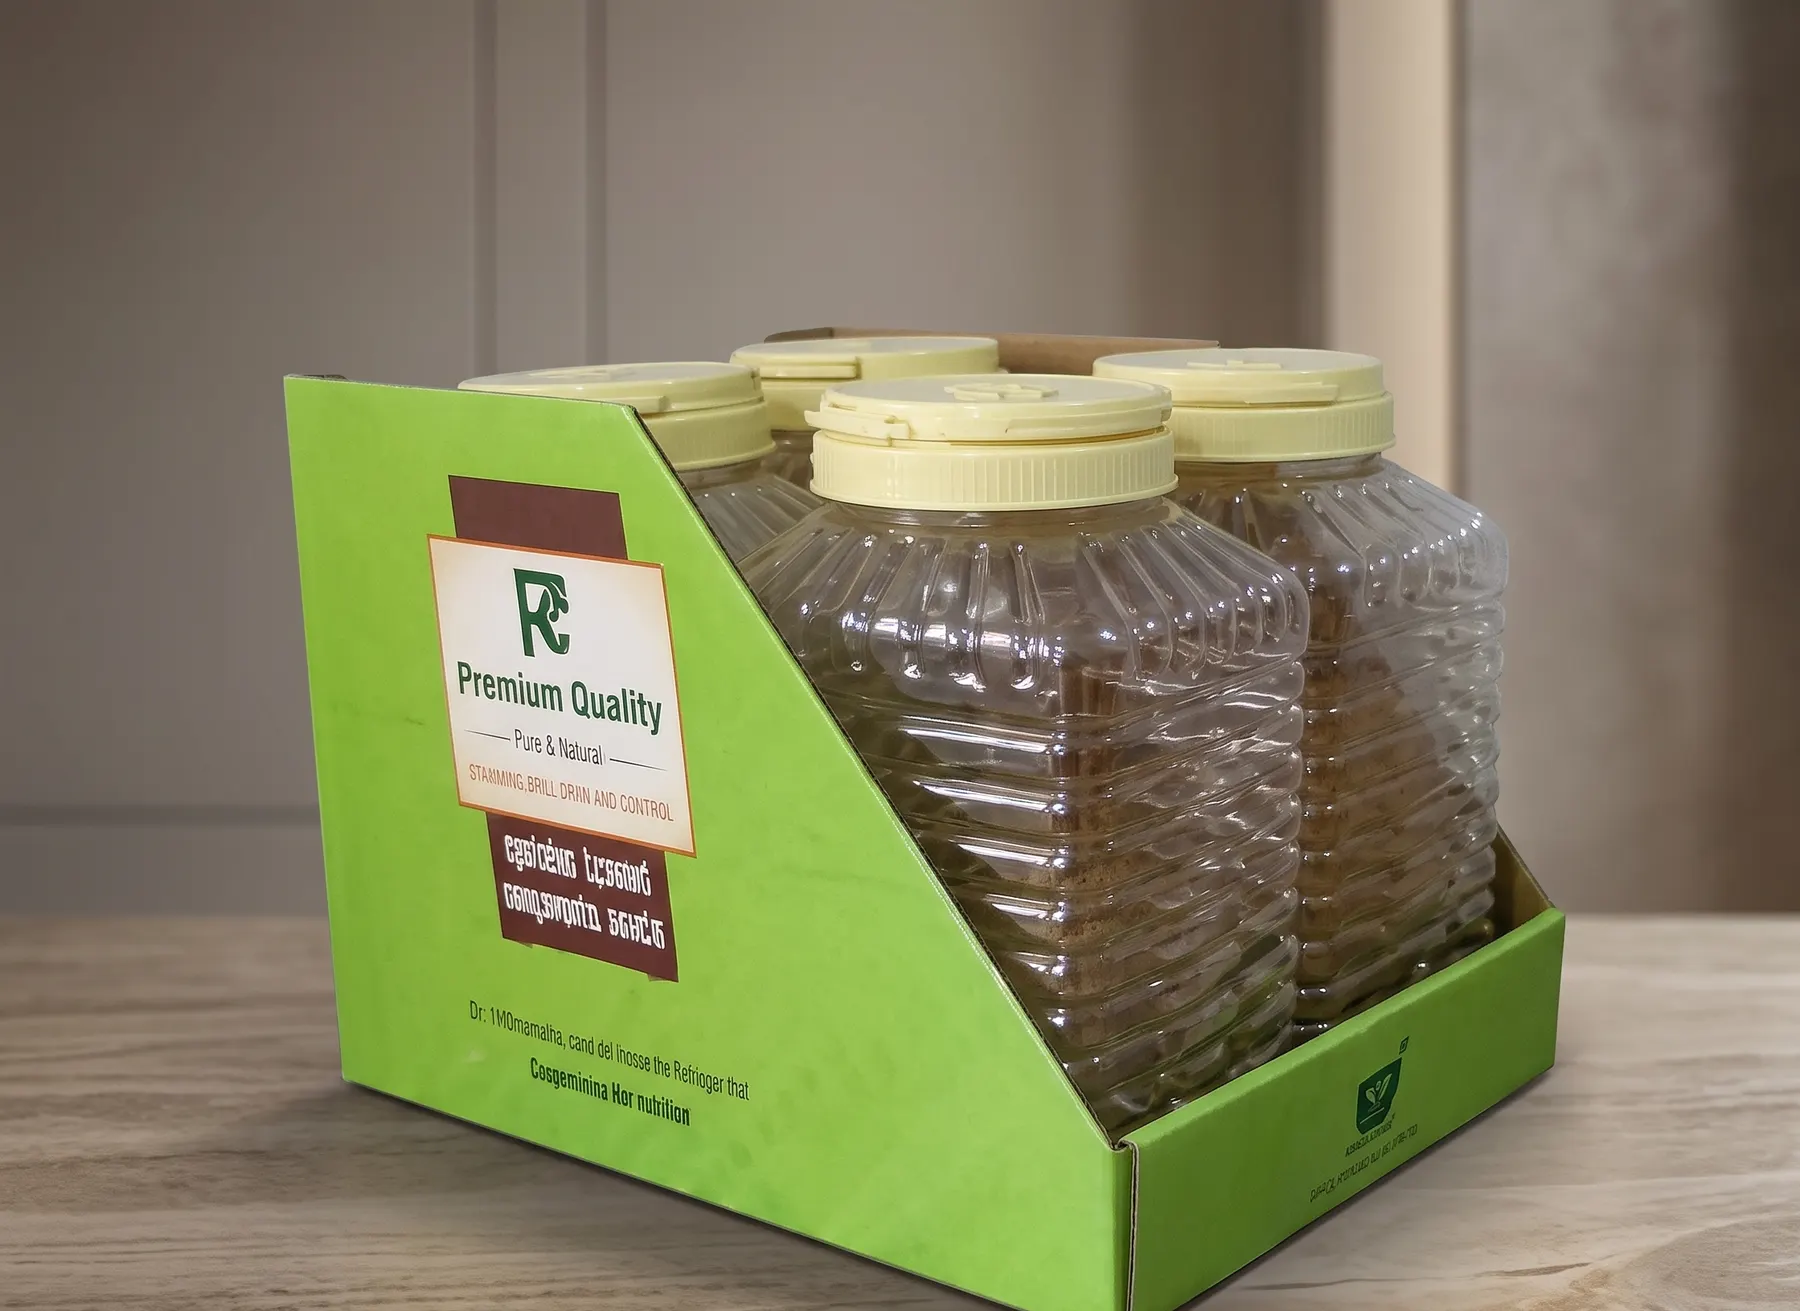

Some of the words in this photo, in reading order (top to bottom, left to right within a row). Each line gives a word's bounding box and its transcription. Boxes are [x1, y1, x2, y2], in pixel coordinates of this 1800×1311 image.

[457, 661, 563, 712] Premium
[571, 681, 662, 735] Quality
[514, 729, 542, 753] Pure
[546, 735, 555, 756] &
[559, 737, 603, 766] Natural
[594, 789, 617, 810] AND
[620, 794, 674, 822] CONTROL
[569, 1034, 594, 1056] cand
[598, 1039, 613, 1060] del
[654, 1056, 670, 1078] the
[727, 1076, 749, 1101] that
[637, 1094, 690, 1126] nutrition
